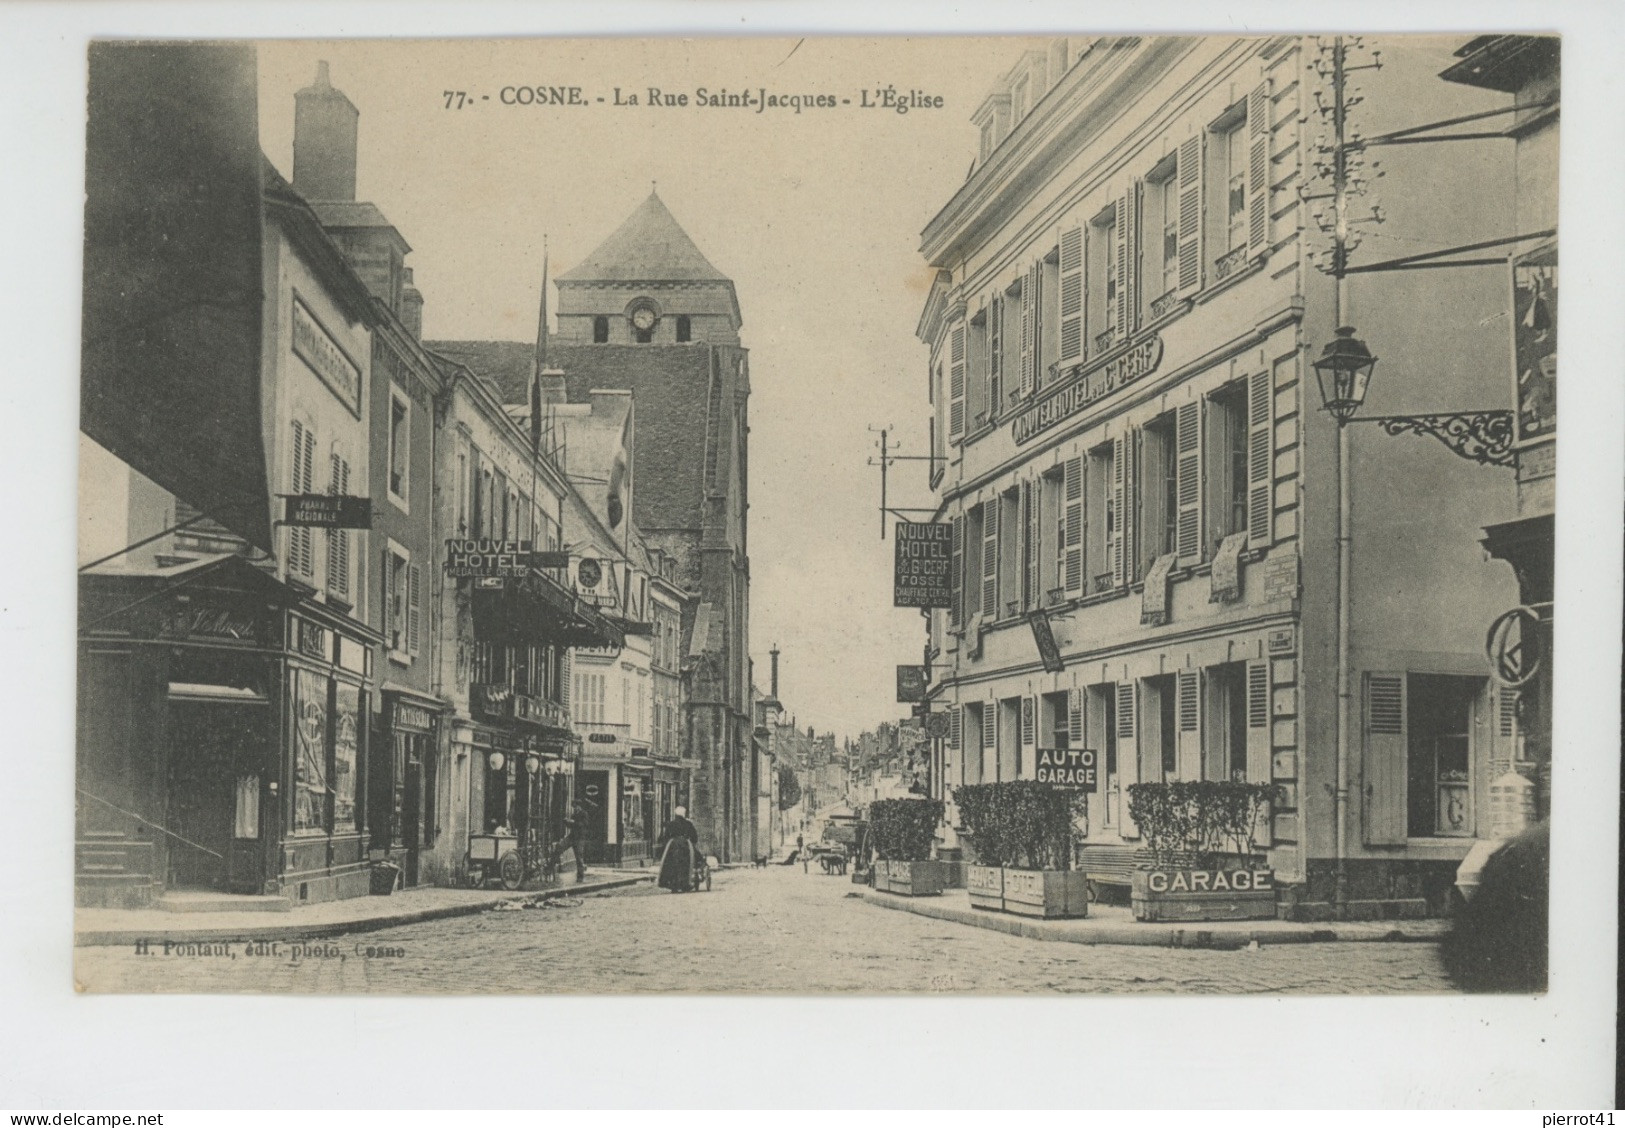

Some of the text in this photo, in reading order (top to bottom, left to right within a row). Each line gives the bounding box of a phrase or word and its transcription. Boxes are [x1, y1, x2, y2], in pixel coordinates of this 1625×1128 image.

[897, 524, 951, 540] NOUVEL
[451, 540, 531, 554] NOUVEL
[899, 541, 947, 558] HOTEL
[1040, 750, 1094, 767] AUTO
[1037, 768, 1095, 784] GARAGE
[1149, 870, 1272, 893] GARAGE
